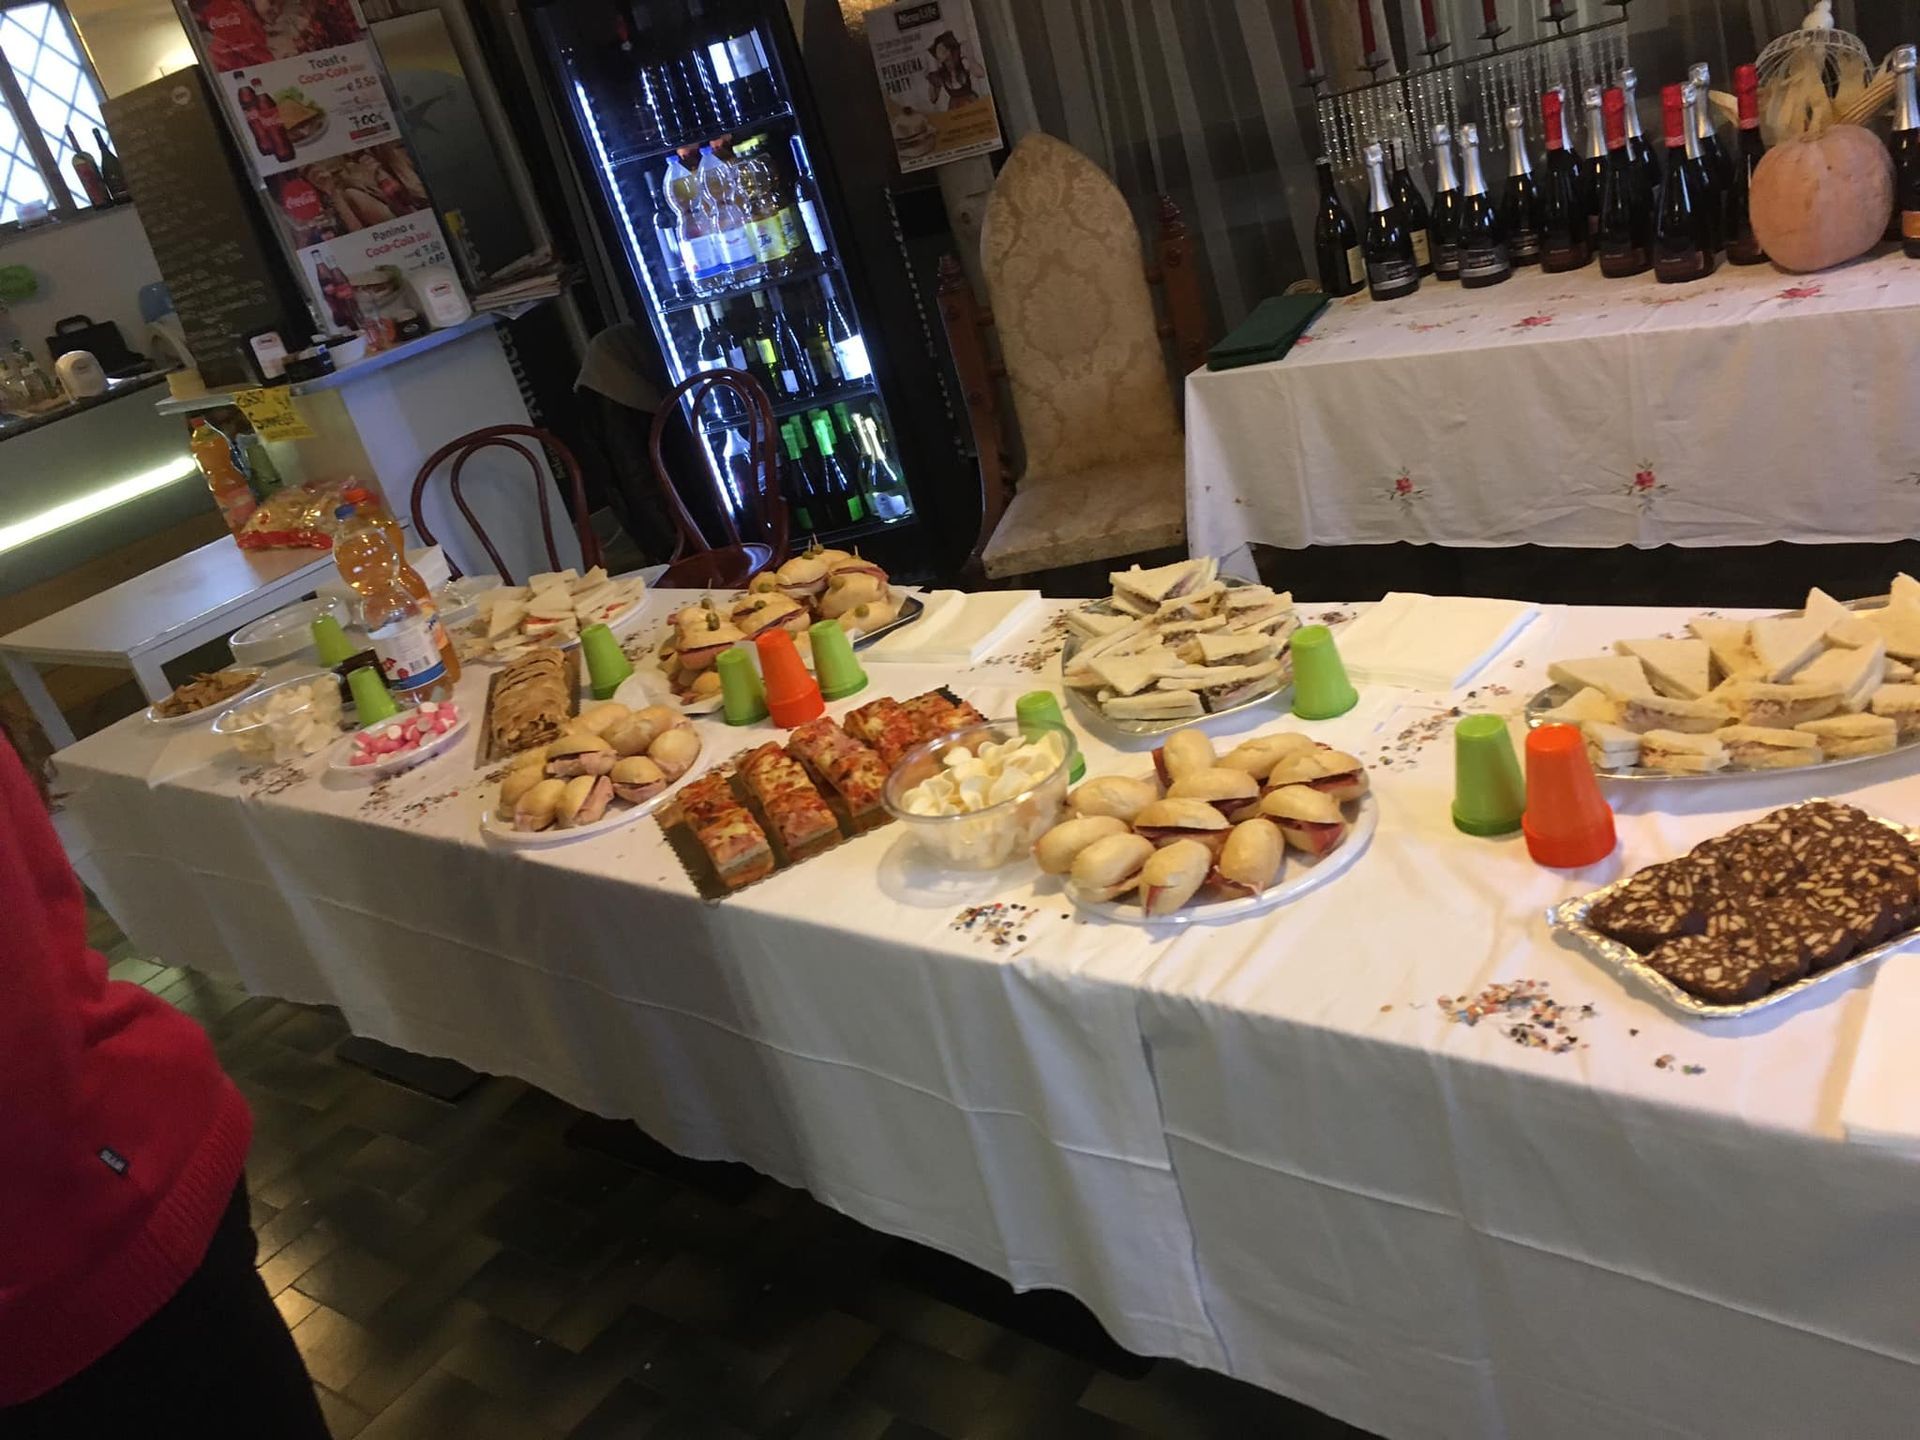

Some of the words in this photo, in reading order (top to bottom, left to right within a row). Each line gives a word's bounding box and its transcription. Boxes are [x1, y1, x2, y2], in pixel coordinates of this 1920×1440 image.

[308, 55, 340, 69] Toast
[298, 64, 349, 84] Coca-Cola
[885, 77, 912, 95] PARTY
[372, 225, 407, 242] Panino
[365, 236, 415, 257] Coca-Cola
